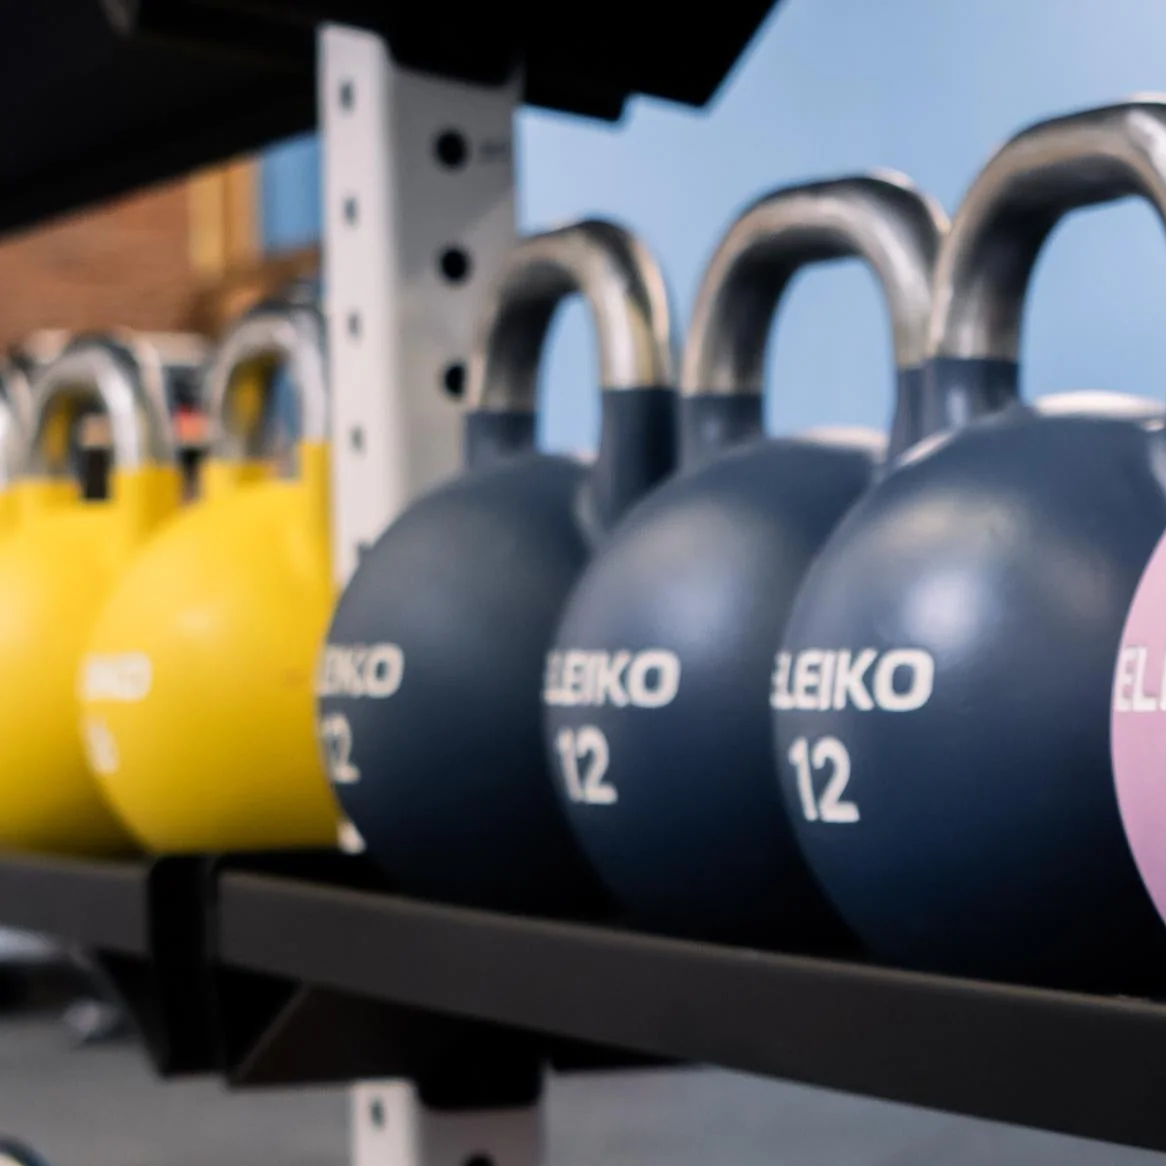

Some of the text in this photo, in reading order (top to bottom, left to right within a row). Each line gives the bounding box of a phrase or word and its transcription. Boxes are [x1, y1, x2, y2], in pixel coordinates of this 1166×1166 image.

[320, 711, 361, 784] 2
[556, 724, 618, 805] 12
[788, 736, 861, 823] 12
